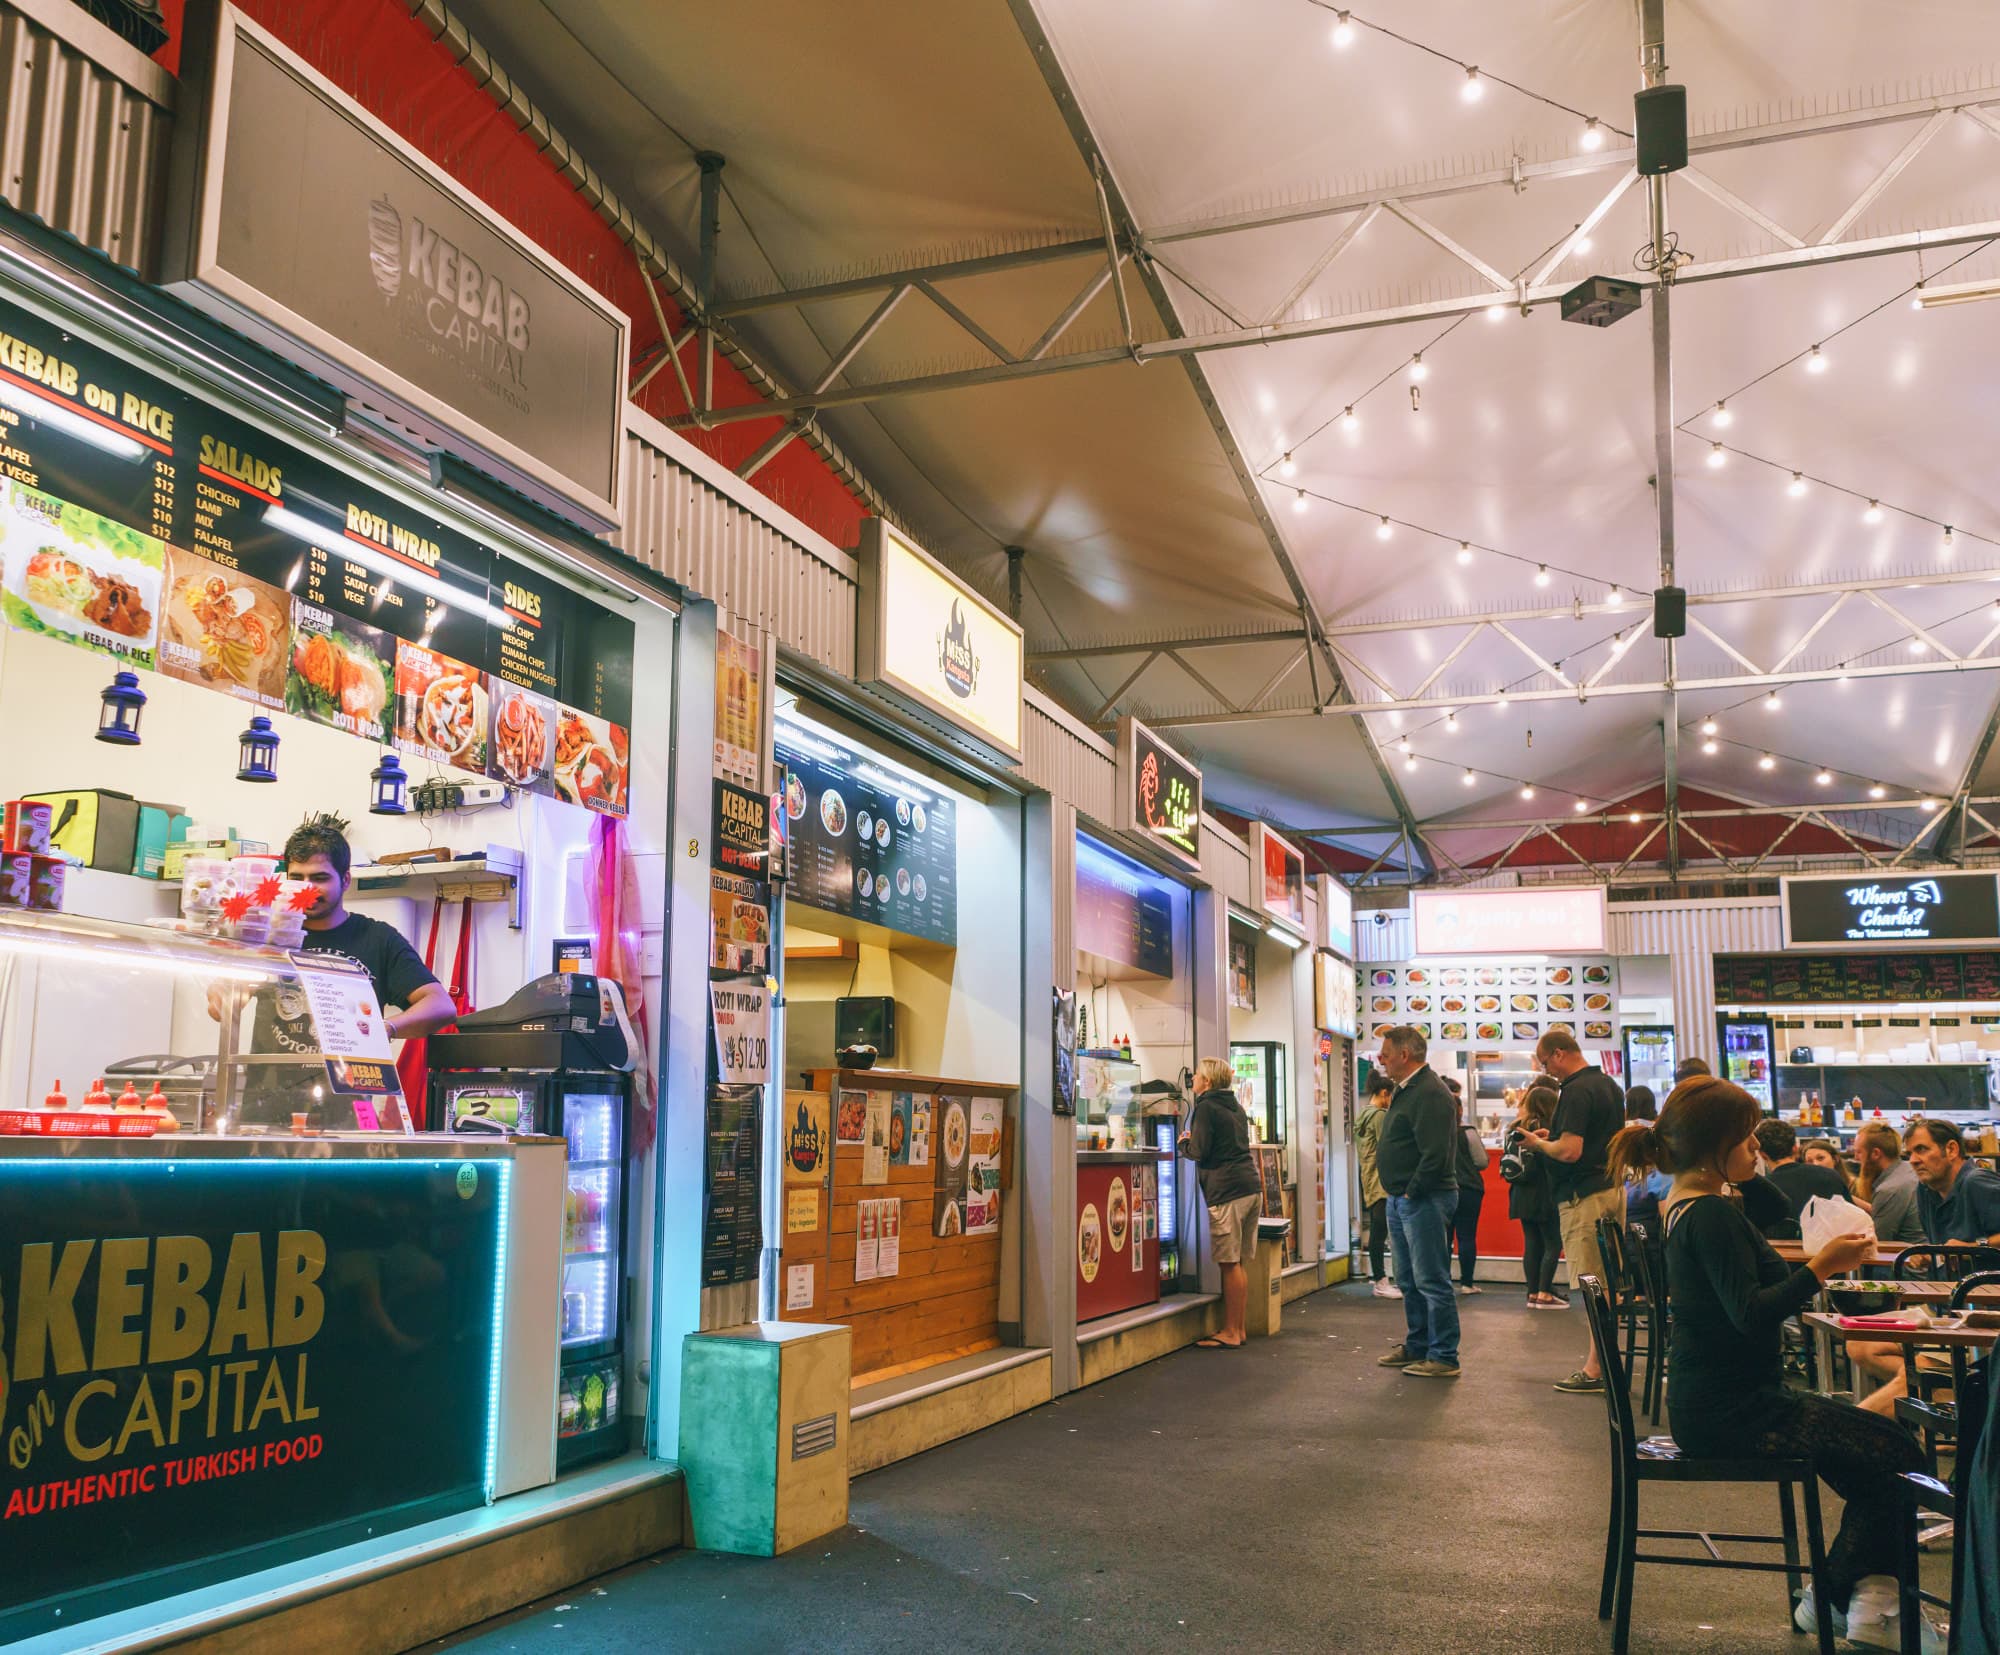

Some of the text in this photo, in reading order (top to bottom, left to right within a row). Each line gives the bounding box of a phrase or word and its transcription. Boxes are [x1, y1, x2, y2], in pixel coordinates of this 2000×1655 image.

[409, 216, 531, 351] KEBAB
[426, 297, 528, 391] CAPITAL
[0, 331, 175, 442] KEBAB on RICE
[0, 443, 32, 467] LAFEL
[200, 434, 283, 497] SALADS
[6, 463, 39, 487] VEGE
[155, 461, 177, 479] $12
[154, 477, 176, 494] $12
[197, 483, 240, 509] CHICKEN
[25, 494, 63, 519] KEBAB
[153, 493, 174, 510] $12
[196, 498, 223, 517] LAMB
[152, 508, 173, 525] $10
[195, 513, 214, 529] MIX
[151, 524, 172, 540] $12
[194, 528, 233, 553] FALAFEL
[347, 503, 441, 568] ROTI WRAP
[194, 544, 239, 569] MIX VEGE
[311, 547, 327, 562] $10
[310, 561, 326, 576] $10
[345, 561, 367, 578] LAMB
[309, 575, 320, 588] $9
[344, 575, 369, 592] SATAY
[308, 589, 324, 604] $10
[344, 588, 365, 606] VEGE
[504, 581, 541, 618] SIDES
[304, 605, 334, 625] KEBAB
[502, 632, 528, 650] WEDGES
[517, 626, 534, 641] CHIPS
[83, 631, 152, 664] KEBAB ON RICE
[501, 657, 557, 687] CHICKEN NUGGETS
[528, 656, 545, 670] CHIPS
[500, 669, 533, 689] COLESLAW
[332, 710, 384, 738] ROTI WRAP
[609, 802, 625, 815] KEBAB
[721, 789, 764, 829] KEBAB
[727, 819, 762, 846] CAPITAL
[688, 838, 699, 858] 8
[712, 876, 755, 898] KEBAB SALAD
[1859, 905, 1925, 926] Charlie?
[714, 991, 763, 1013] ROTI WRAP
[738, 1033, 767, 1072] $12.90
[352, 1065, 382, 1079] KEBAB
[360, 1078, 385, 1087] CAPITAL
[794, 1129, 816, 1151] MISS
[14, 1229, 327, 1382] KEBAB
[64, 1353, 321, 1463] CAPITAL
[9, 1389, 56, 1469] on
[4, 1434, 324, 1519] AUTHENTIC TURKISH FOOD
